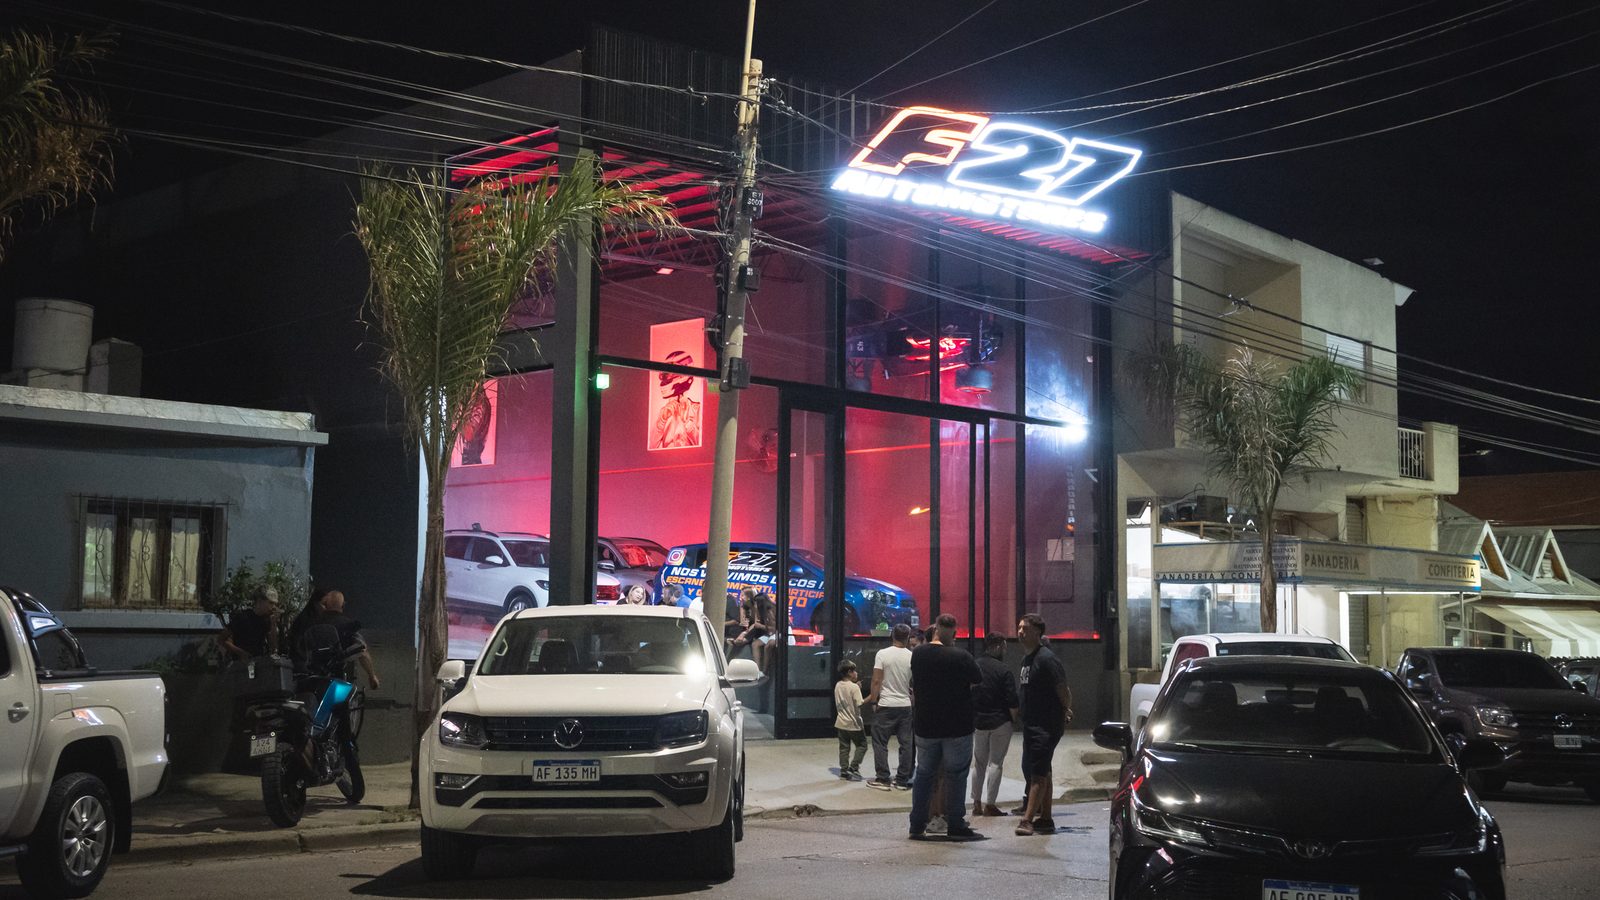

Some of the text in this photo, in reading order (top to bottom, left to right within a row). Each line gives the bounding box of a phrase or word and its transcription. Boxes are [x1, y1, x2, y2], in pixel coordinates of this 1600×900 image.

[847, 105, 1143, 206] F27
[831, 168, 1108, 233] AUTOMOTORES
[1304, 552, 1475, 579] PANADERIA CONFITERIA
[666, 575, 705, 587] ESCANE
[670, 566, 699, 577] NOS
[770, 575, 817, 588] LCOS
[1220, 571, 1226, 580] Y
[1231, 571, 1297, 581] CONFRIA
[687, 587, 695, 596] Y
[536, 767, 597, 780] AF 135 MH
